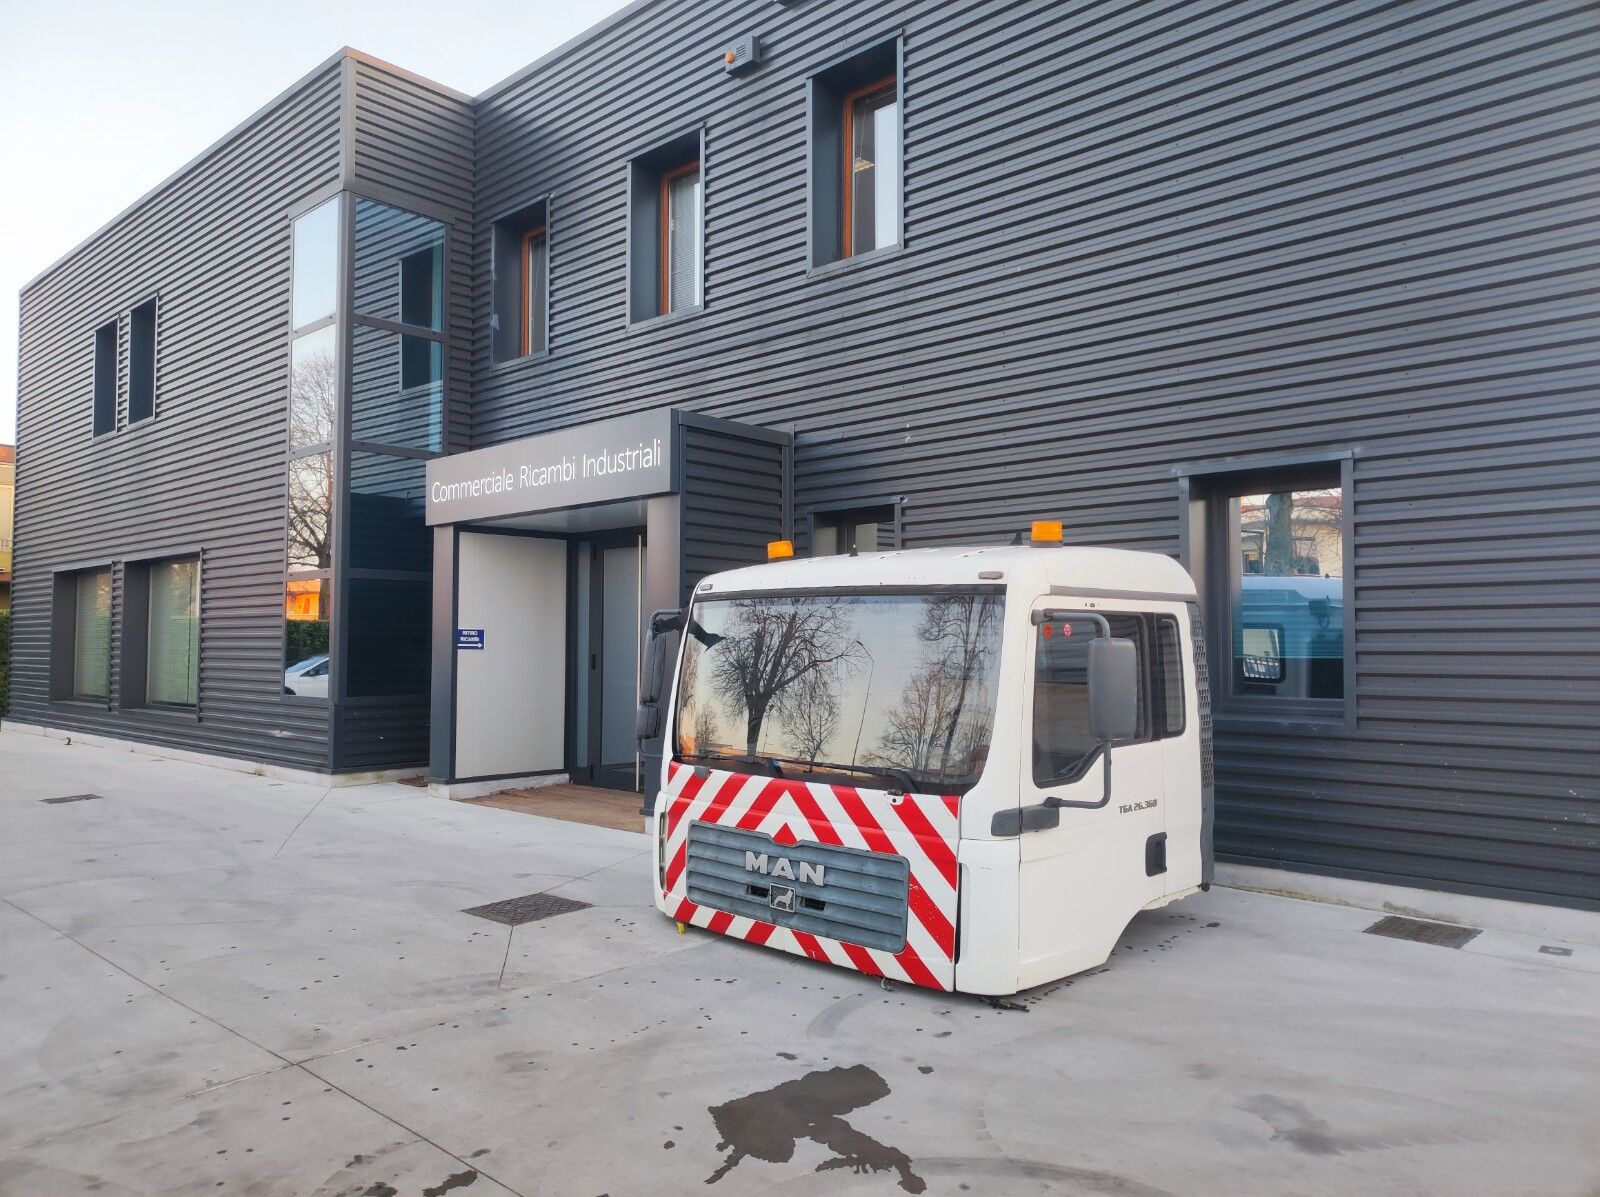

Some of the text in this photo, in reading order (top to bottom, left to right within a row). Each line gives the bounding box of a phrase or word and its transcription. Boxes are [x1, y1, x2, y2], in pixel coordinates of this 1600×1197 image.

[432, 438, 661, 503] Commerciale Ricambi Industriali
[745, 850, 825, 887] MAN
